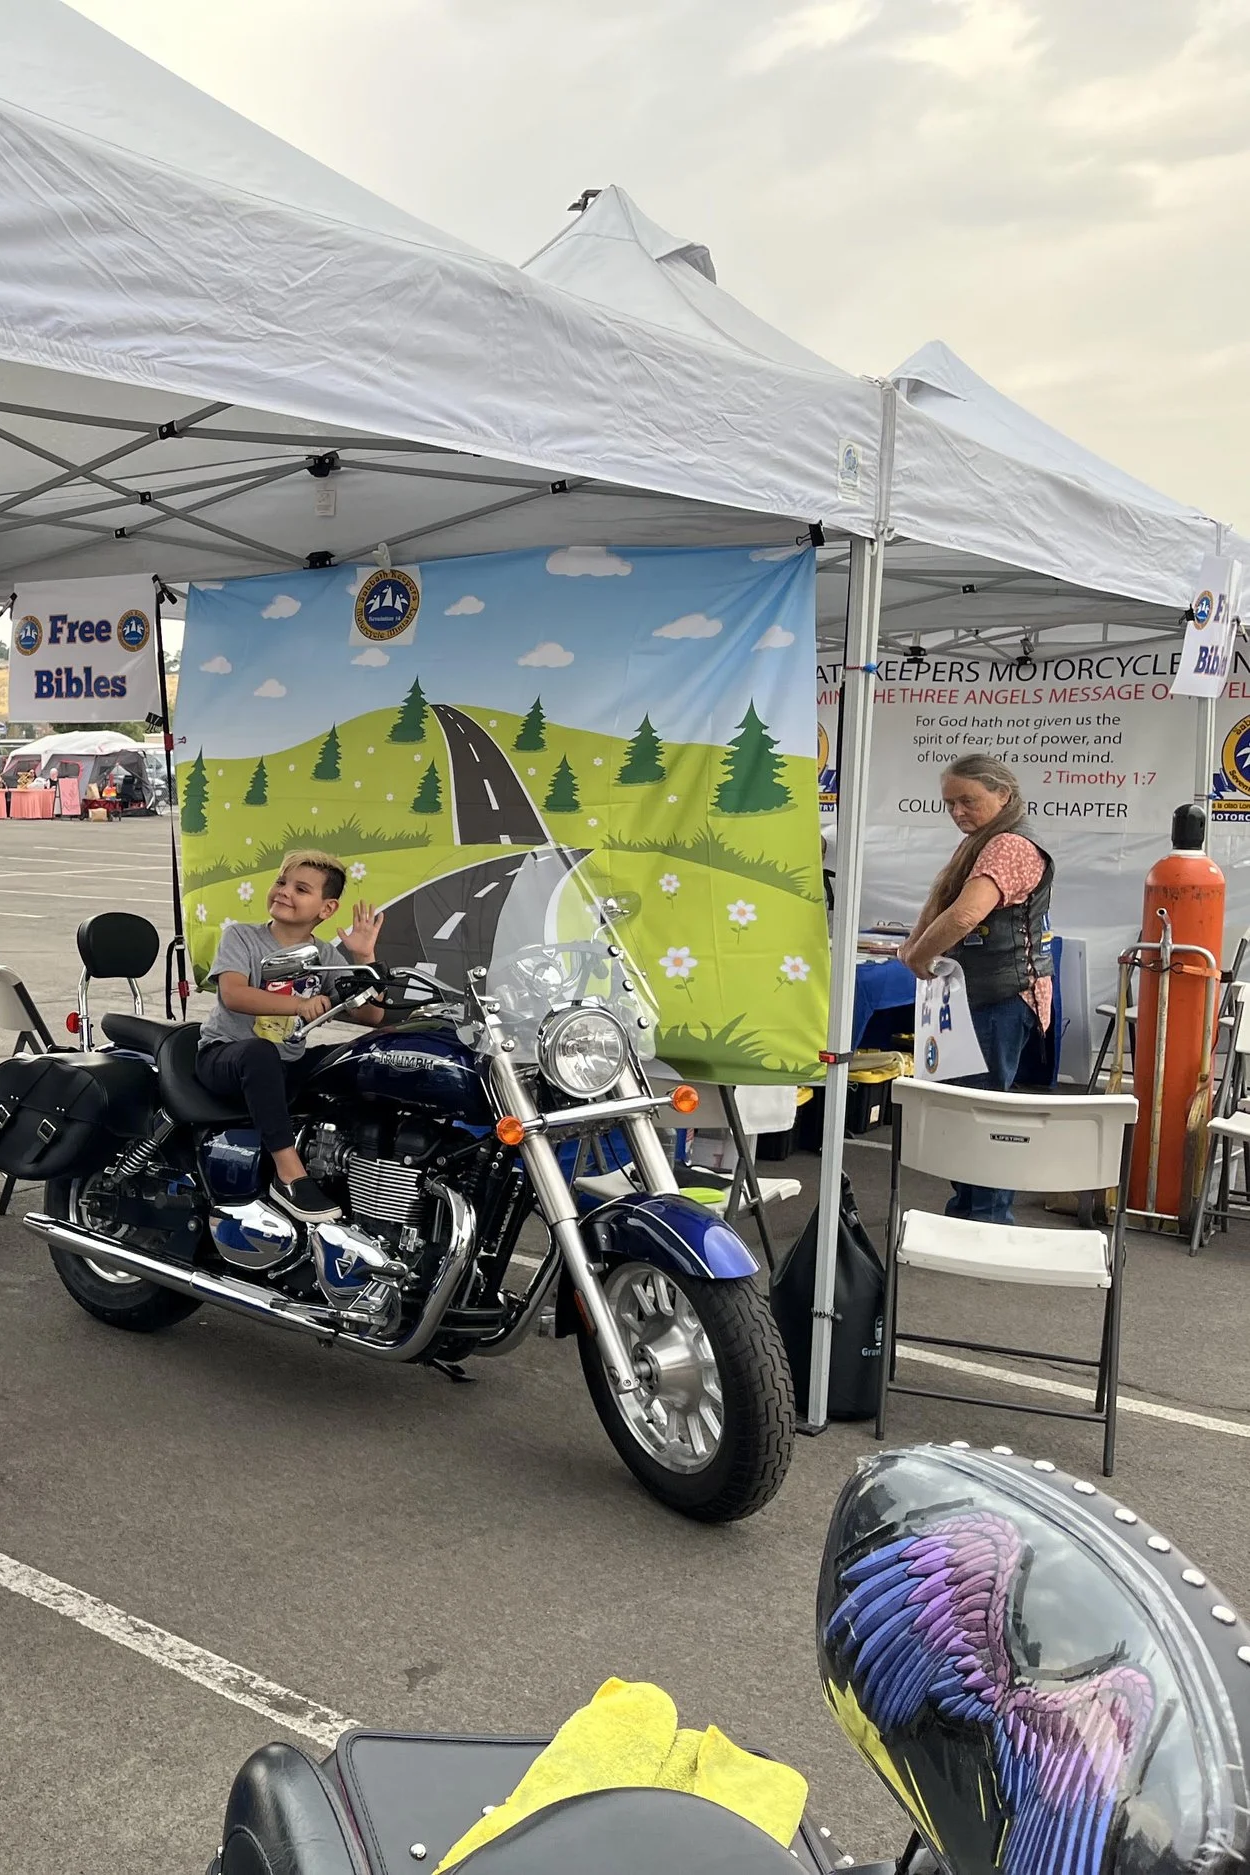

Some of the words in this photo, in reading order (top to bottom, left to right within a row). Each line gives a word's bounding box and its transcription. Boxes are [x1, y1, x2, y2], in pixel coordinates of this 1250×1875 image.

[48, 614, 112, 645] Free
[874, 661, 979, 682] KEEPERS
[988, 653, 1182, 683] MOTORCYCLE
[34, 666, 127, 699] Bibles
[900, 688, 959, 704] THREE
[964, 688, 1043, 705] ANGELS
[1049, 683, 1145, 704] MESSAGE
[916, 716, 935, 727] For
[939, 716, 967, 727] God
[971, 716, 1002, 728] hath
[1006, 717, 1030, 728] not
[1034, 716, 1071, 730] given
[1076, 715, 1091, 726] us
[1096, 713, 1121, 726] the
[913, 733, 944, 748] spirit
[946, 733, 962, 745] of
[963, 733, 993, 746] fear;
[997, 733, 1020, 745] but
[1023, 732, 1040, 745] of
[1041, 734, 1089, 748] power,
[1093, 732, 1122, 745] and
[917, 751, 931, 762] of
[1011, 753, 1019, 763] a
[1023, 752, 1067, 763] sound
[1073, 751, 1114, 763] mind.
[1043, 771, 1052, 784] 2
[1057, 770, 1127, 788] Timothy
[1133, 772, 1156, 785] 1:7
[1043, 801, 1128, 818] CHAPTER
[379, 1052, 434, 1071] TRIUMPH
